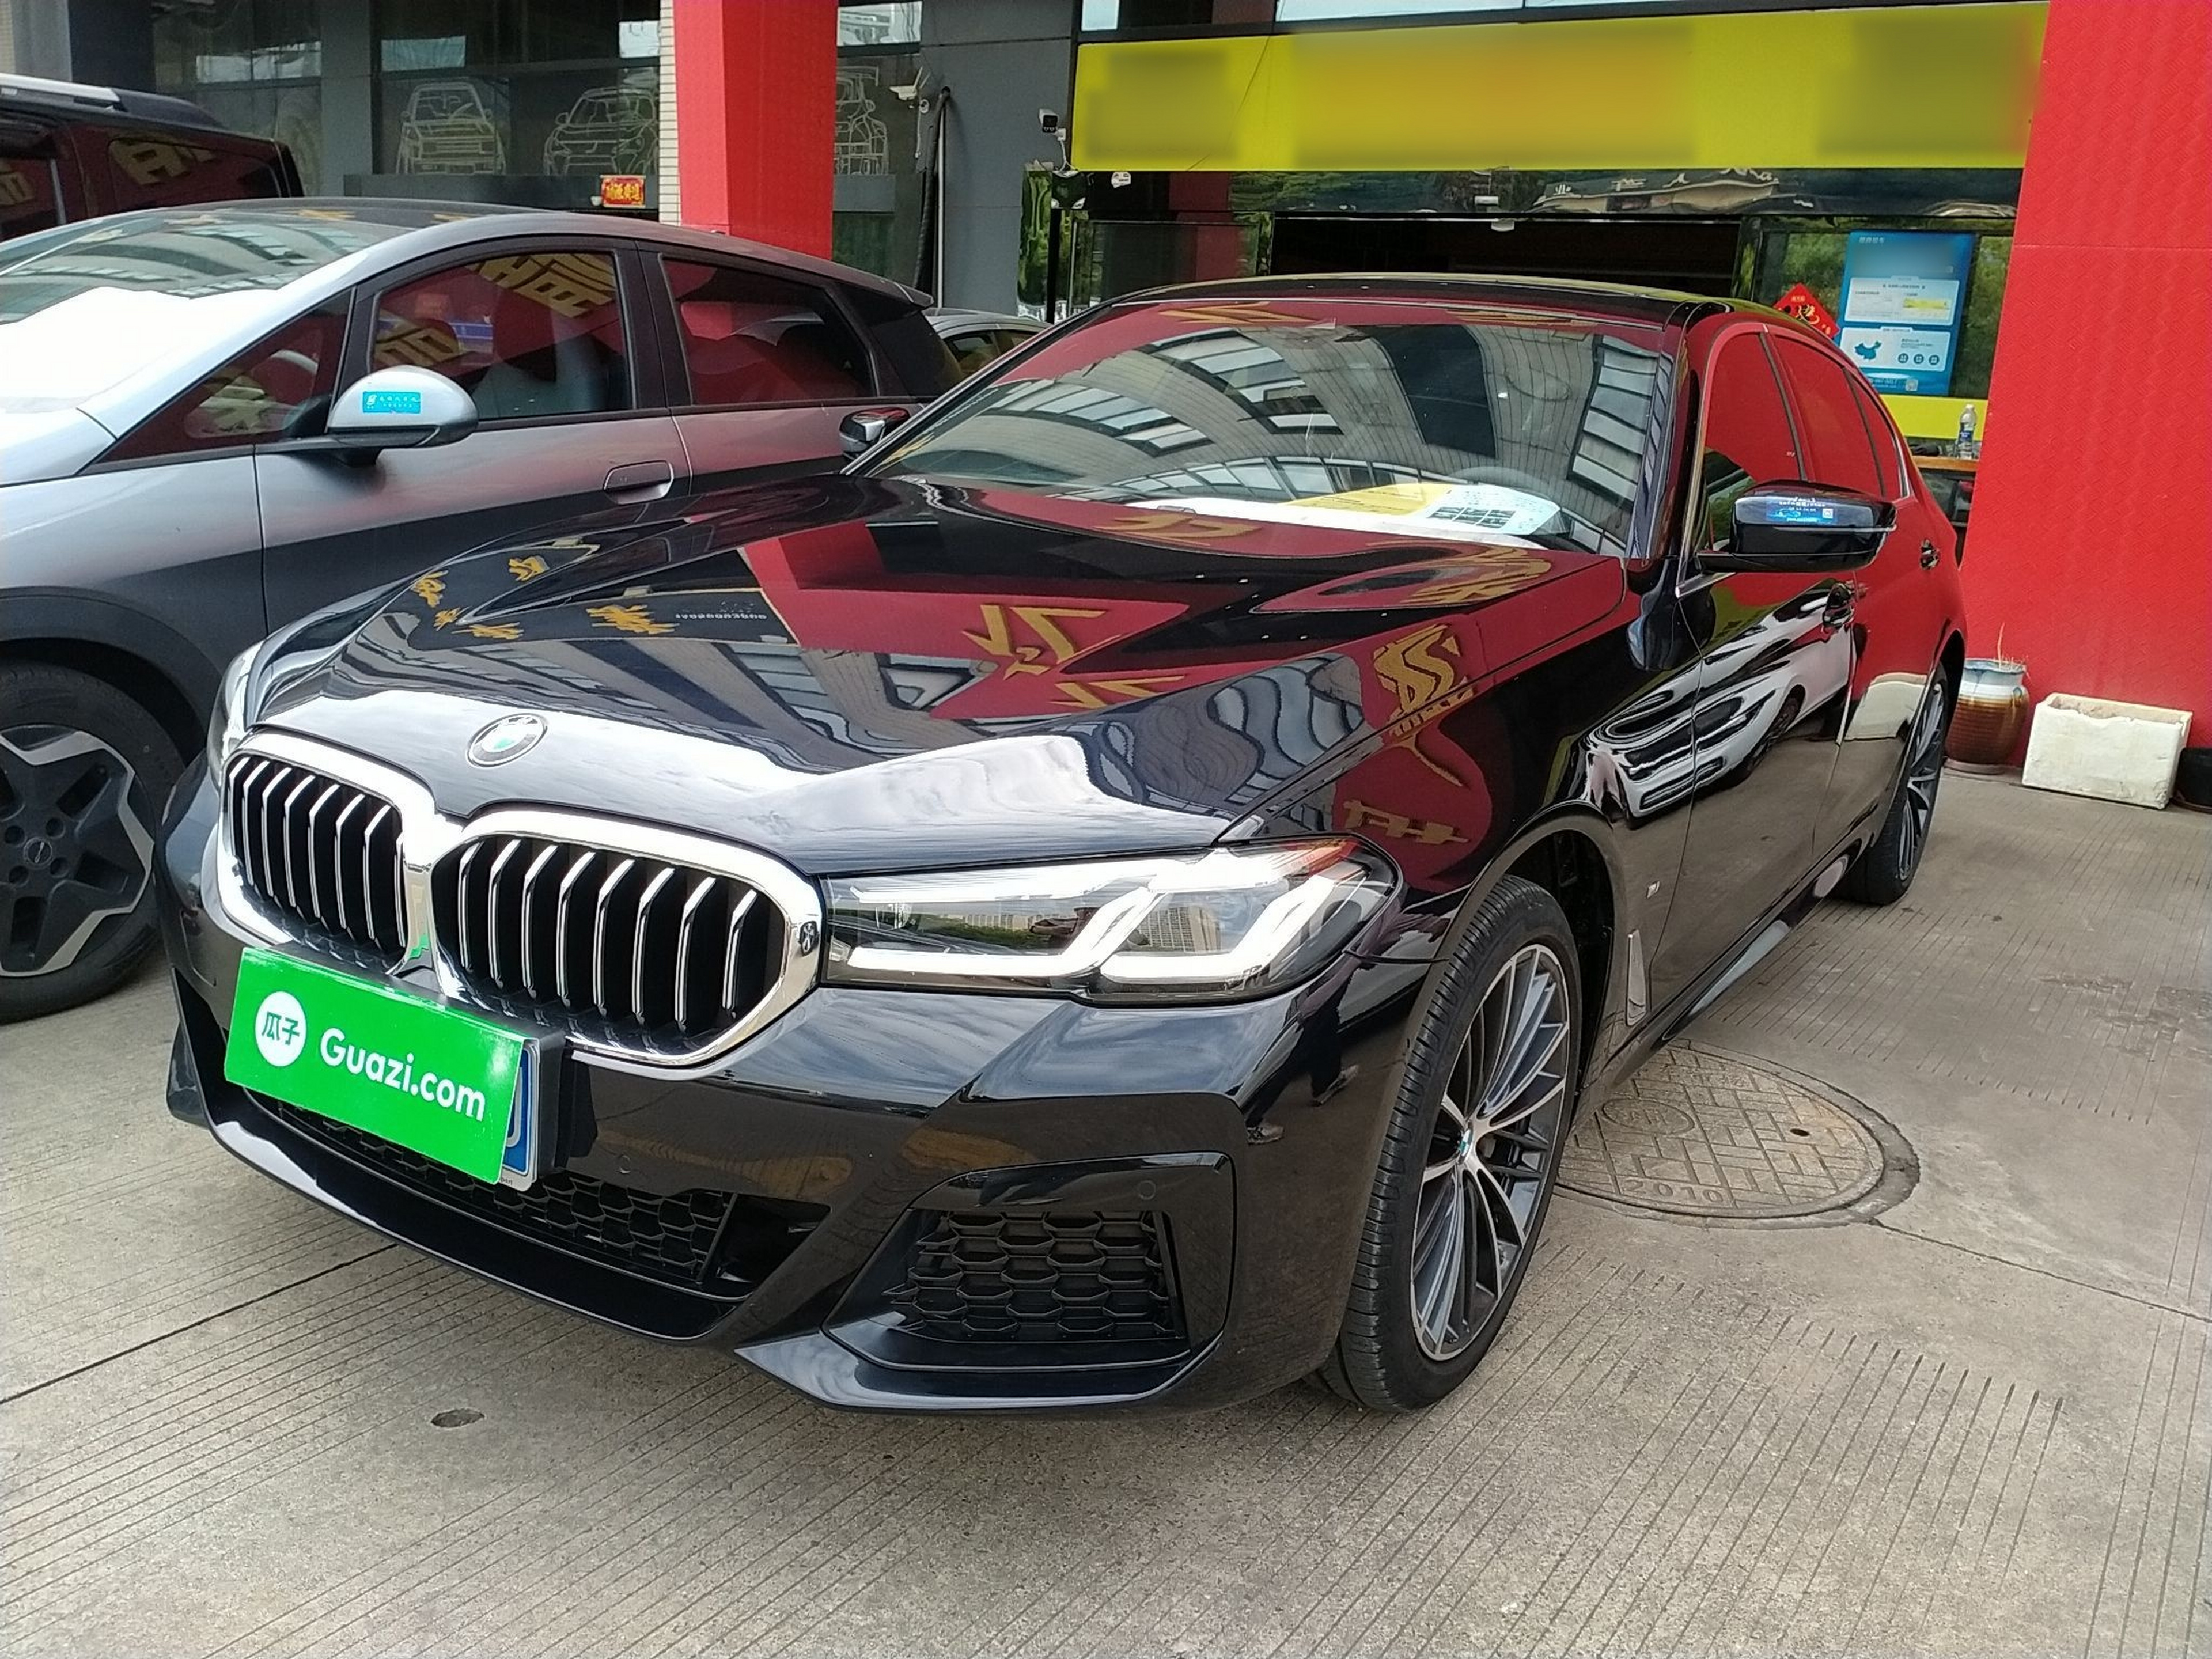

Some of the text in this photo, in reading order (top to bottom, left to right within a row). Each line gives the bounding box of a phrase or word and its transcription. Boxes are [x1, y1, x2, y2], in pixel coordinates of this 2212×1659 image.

[262, 1012, 300, 1045] 瓜子
[320, 1028, 486, 1121] Guazi.com
[1623, 1179, 1723, 1203] 2010
